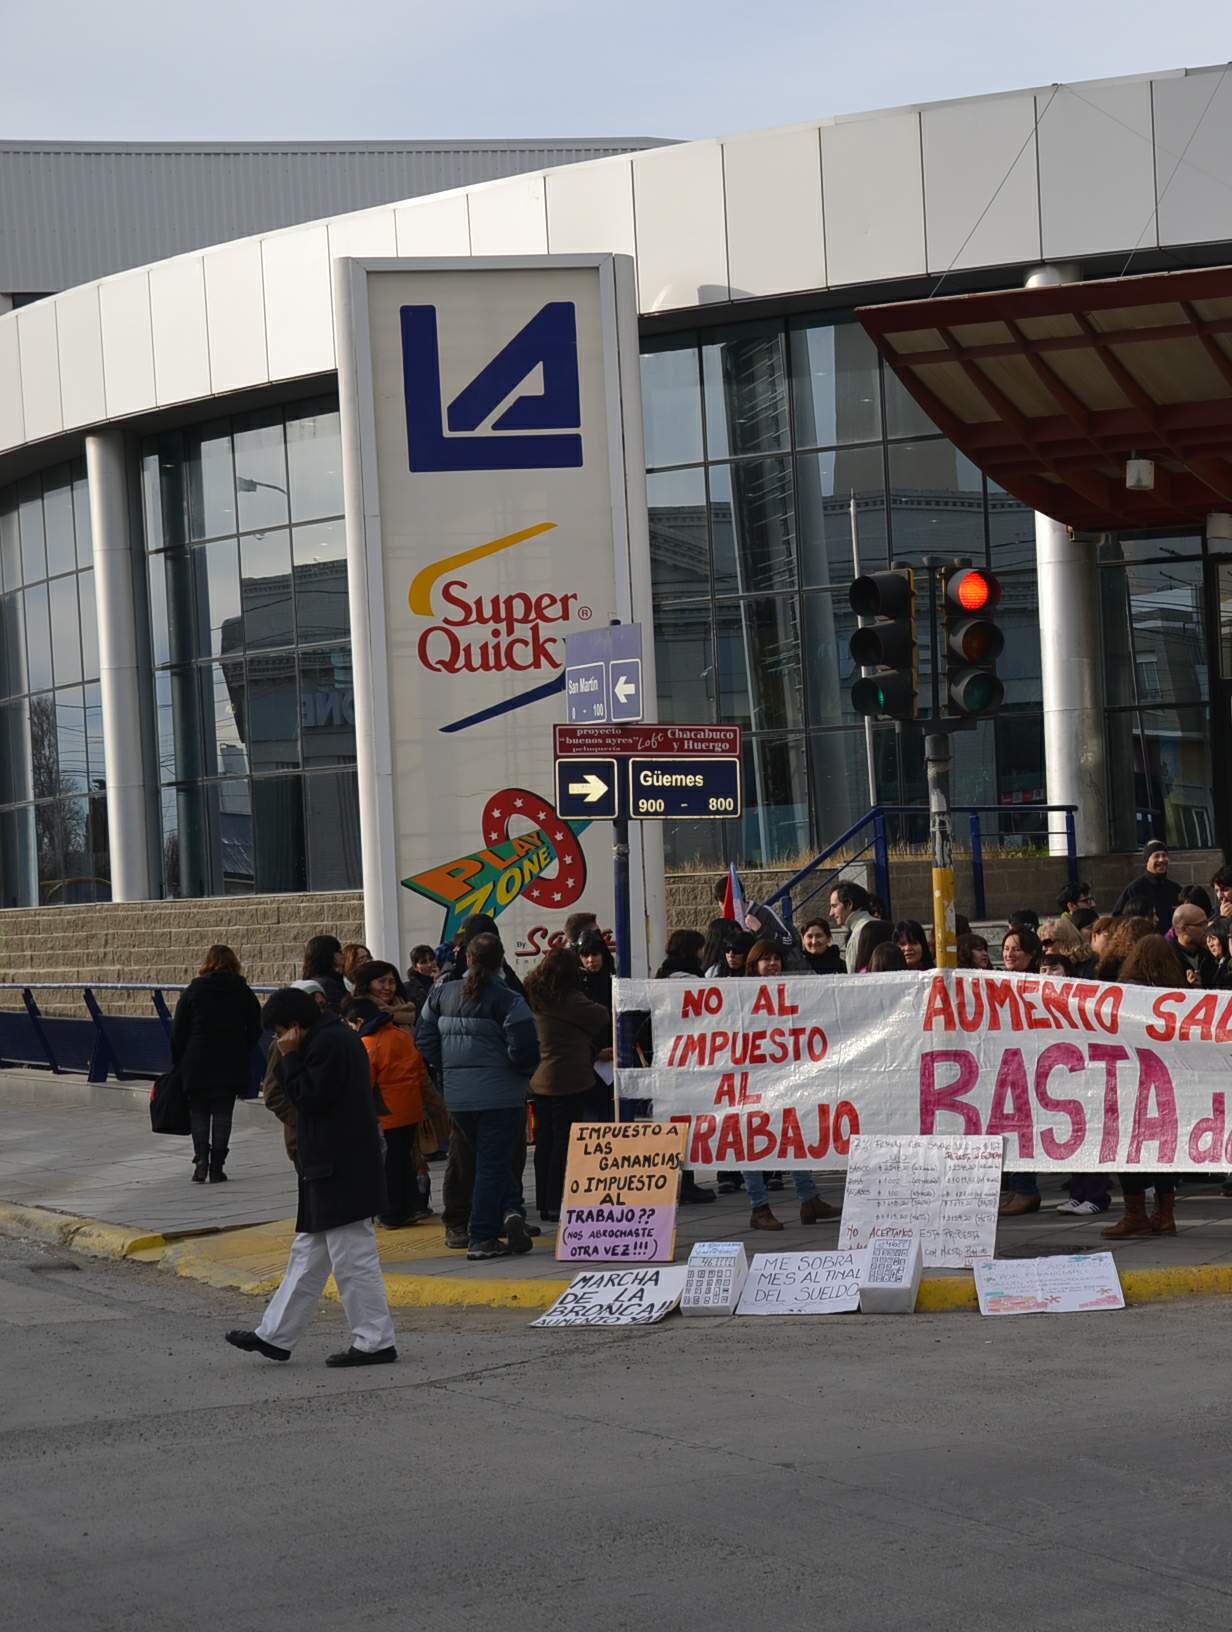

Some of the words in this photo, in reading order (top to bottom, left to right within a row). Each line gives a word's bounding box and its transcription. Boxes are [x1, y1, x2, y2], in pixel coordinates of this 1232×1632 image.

[441, 580, 579, 637] Super
[417, 622, 564, 674] Quick
[568, 680, 578, 695] San
[593, 703, 604, 717] 100
[667, 728, 734, 739] Chacabuco
[673, 742, 680, 751] y
[684, 740, 730, 752] Huergo
[639, 770, 704, 787] Güemes
[638, 799, 665, 813] 900
[708, 797, 734, 812] 800
[409, 830, 547, 901] PLAY
[681, 986, 724, 1019] NO
[751, 984, 799, 1017] AL
[922, 975, 1124, 1035] AUMENTO
[667, 1026, 829, 1067] IMPUESTO
[713, 1071, 762, 1107] AL
[919, 1042, 1179, 1165] BASTA
[577, 1124, 662, 1141] IMPUESTO
[666, 1125, 679, 1136] A
[584, 1142, 613, 1155] LAS
[599, 1152, 681, 1171] GANANCIAS
[570, 1180, 580, 1194] O
[584, 1174, 668, 1193] IMPUESTO
[600, 1192, 626, 1206] AL
[570, 1245, 600, 1257] OTRA
[797, 1254, 854, 1271] SOBRA
[569, 1270, 661, 1289] MARCHA
[758, 1271, 796, 1286] MES
[800, 1271, 821, 1284] AL
[558, 1291, 598, 1305] DE
[612, 1287, 645, 1302] LA
[794, 1282, 861, 1301] SUELDO
